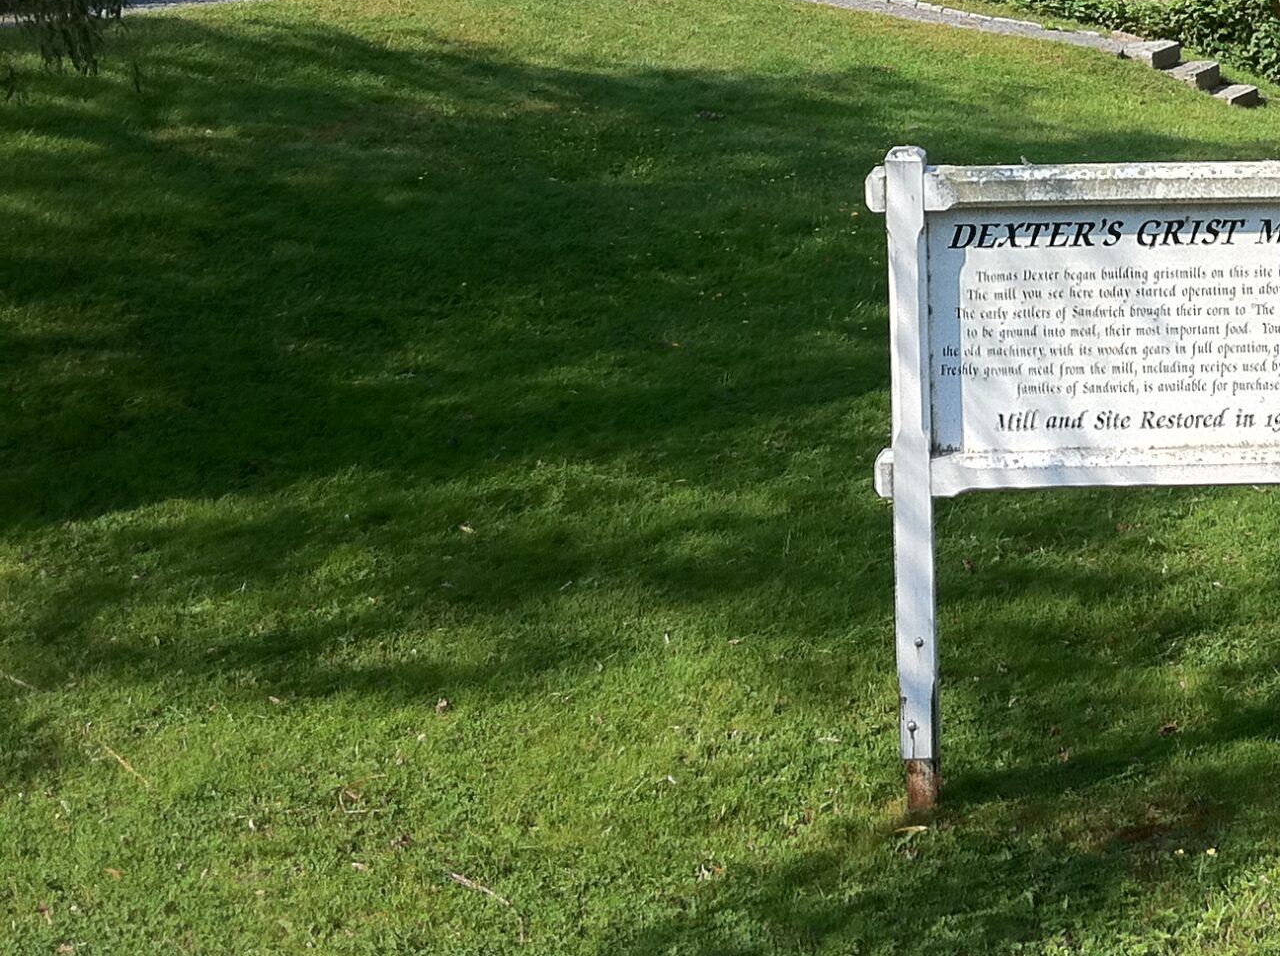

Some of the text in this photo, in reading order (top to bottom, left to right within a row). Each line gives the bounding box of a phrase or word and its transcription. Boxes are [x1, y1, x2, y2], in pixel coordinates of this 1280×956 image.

[948, 218, 1124, 249] DEXTER'S
[1137, 216, 1245, 249] GRIST
[976, 270, 1018, 283] Thomas
[1023, 270, 1059, 281] Dexter
[1064, 268, 1096, 285] began
[1101, 266, 1148, 284] building
[1153, 267, 1206, 284] gristmills
[1212, 268, 1224, 278] on
[1229, 266, 1249, 278] this
[1254, 265, 1273, 278] site
[967, 289, 988, 300] The
[994, 288, 1016, 299] mill
[1021, 288, 1042, 303] you
[1048, 290, 1064, 299] see
[1069, 287, 1094, 299] here
[1099, 286, 1130, 303] today
[1136, 285, 1176, 297] started
[1182, 284, 1236, 300] operating
[1242, 283, 1253, 295] in
[956, 307, 975, 319] The
[980, 307, 1008, 324] early
[1013, 306, 1051, 319] settlers
[1056, 306, 1067, 323] of
[1072, 305, 1124, 318] Sandwich
[1130, 303, 1171, 320] brought
[1176, 302, 1202, 316] their
[1206, 305, 1230, 315] corn
[1235, 304, 1246, 315] to
[967, 327, 978, 338] to
[982, 327, 994, 337] be
[999, 325, 1038, 342] ground
[1043, 326, 1065, 338] into
[1071, 325, 1100, 339] meal,
[1105, 324, 1131, 337] their
[1136, 325, 1160, 337] most
[1166, 324, 1220, 340] important
[943, 345, 959, 357] the
[964, 344, 981, 357] old
[1050, 344, 1073, 356] with
[1080, 344, 1093, 355] its
[1097, 343, 1137, 355] wooden
[1142, 344, 1170, 360] gears
[1175, 342, 1186, 354] in
[1191, 341, 1212, 359] full
[1217, 341, 1270, 358] operation,
[941, 364, 979, 380] Freshly
[984, 364, 1023, 380] ground
[1028, 363, 1054, 375] meal
[1060, 363, 1085, 377] from
[1090, 363, 1106, 374] the
[1112, 362, 1138, 376] mill,
[1142, 360, 1195, 378] including
[1200, 361, 1237, 377] recipes
[1242, 359, 1267, 372] used
[1017, 381, 1062, 398] families
[1066, 381, 1078, 398] of
[1083, 380, 1139, 395] Sandwich,
[1144, 380, 1153, 392] is
[1158, 379, 1207, 392] available
[1211, 379, 1228, 396] for
[996, 408, 1040, 432] Mill
[1046, 409, 1089, 430] and
[1094, 410, 1131, 430] Site
[1140, 408, 1229, 429] Restored
[1236, 409, 1255, 427] in
